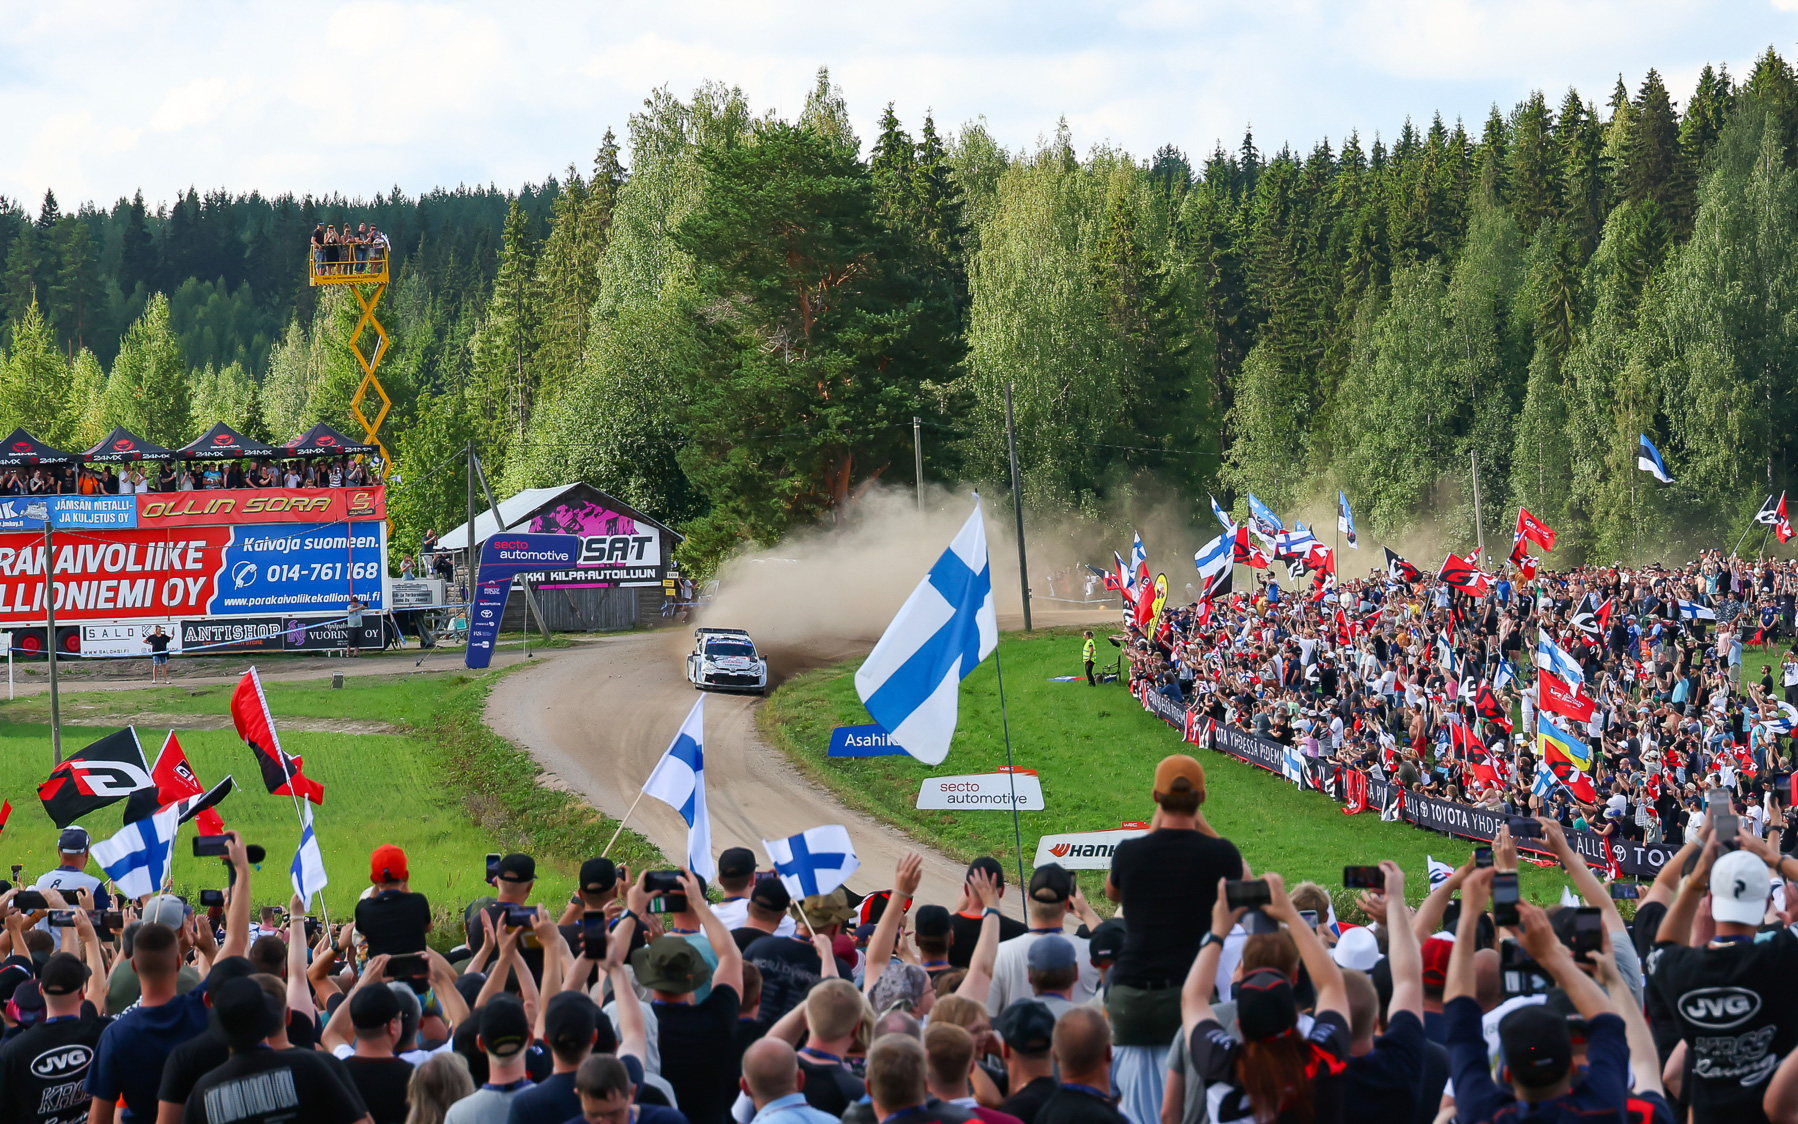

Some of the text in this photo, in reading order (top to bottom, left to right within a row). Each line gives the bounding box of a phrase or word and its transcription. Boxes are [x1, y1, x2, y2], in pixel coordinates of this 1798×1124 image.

[296, 447, 326, 455] 24MX
[54, 498, 133, 511] JÄMSÄN METALLI-
[141, 496, 332, 519] OLLIN SORA
[59, 512, 129, 524] JA KULJETUS OY
[243, 536, 379, 554] Kaivoja suomeen.
[493, 539, 529, 550] secto
[577, 536, 653, 563] SAT
[500, 549, 569, 561] automotive
[266, 561, 379, 583] 014-761 168
[550, 568, 656, 582] KILPA-AUTOILUUN
[161, 576, 207, 608] OY
[88, 628, 134, 638] SALO
[184, 623, 281, 642] ANTISHOP
[309, 629, 379, 640] VUORIN OY
[1215, 726, 1228, 745] OTA
[940, 781, 980, 792] secto
[947, 793, 1028, 804] automotive
[1430, 803, 1470, 829] TOYOTA
[1576, 832, 1606, 860] ÄLLE
[1686, 994, 1751, 1018] JVG
[37, 1049, 87, 1073] JVG
